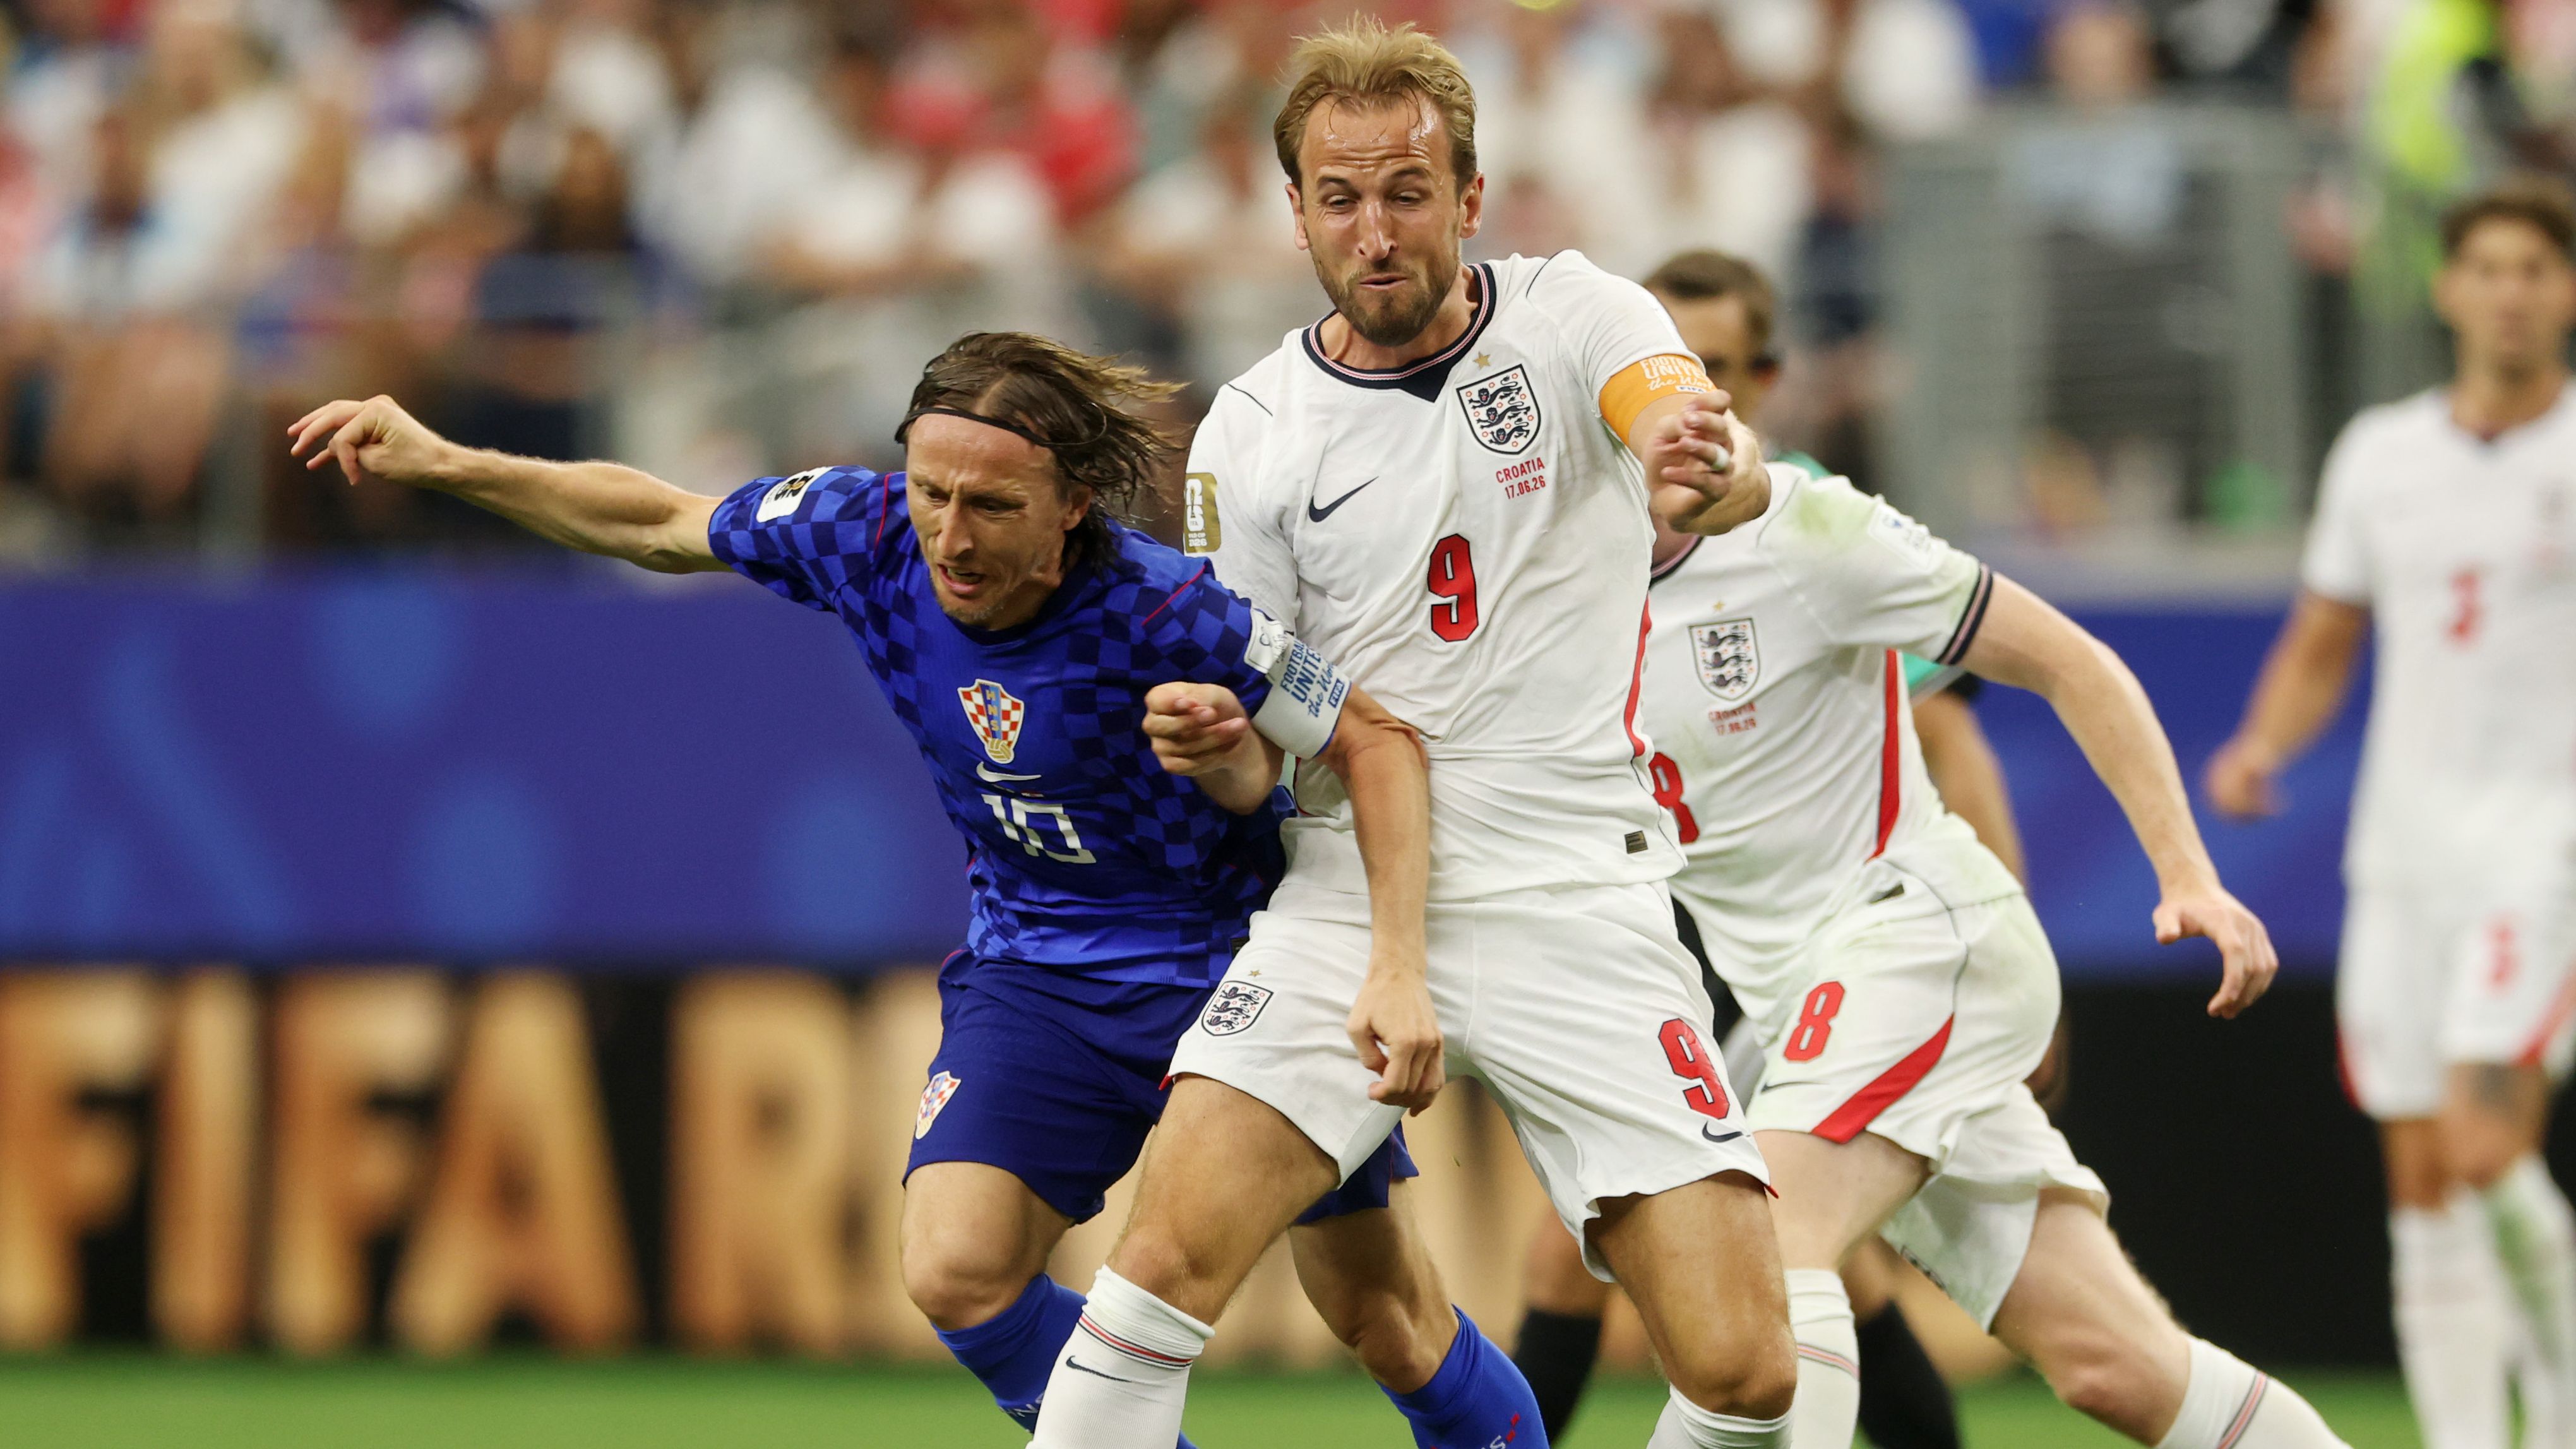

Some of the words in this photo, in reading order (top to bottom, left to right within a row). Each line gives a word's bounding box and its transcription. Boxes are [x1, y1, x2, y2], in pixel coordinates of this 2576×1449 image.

[1644, 365, 1705, 379] UNITE
[1647, 378, 1676, 391] the
[1496, 456, 1545, 483] CROATIA
[1505, 475, 1546, 499] 17.06.26
[1427, 533, 1479, 643] 9
[1291, 647, 1321, 703] UNITE
[1308, 693, 1323, 717] the
[1317, 664, 1333, 692] Wor
[986, 689, 999, 731] HNS
[1649, 751, 1700, 845] 8
[981, 793, 1097, 864] 10
[1784, 981, 1845, 1062] 8
[1658, 1018, 1730, 1119] 9
[0, 966, 639, 1354] FIFA
